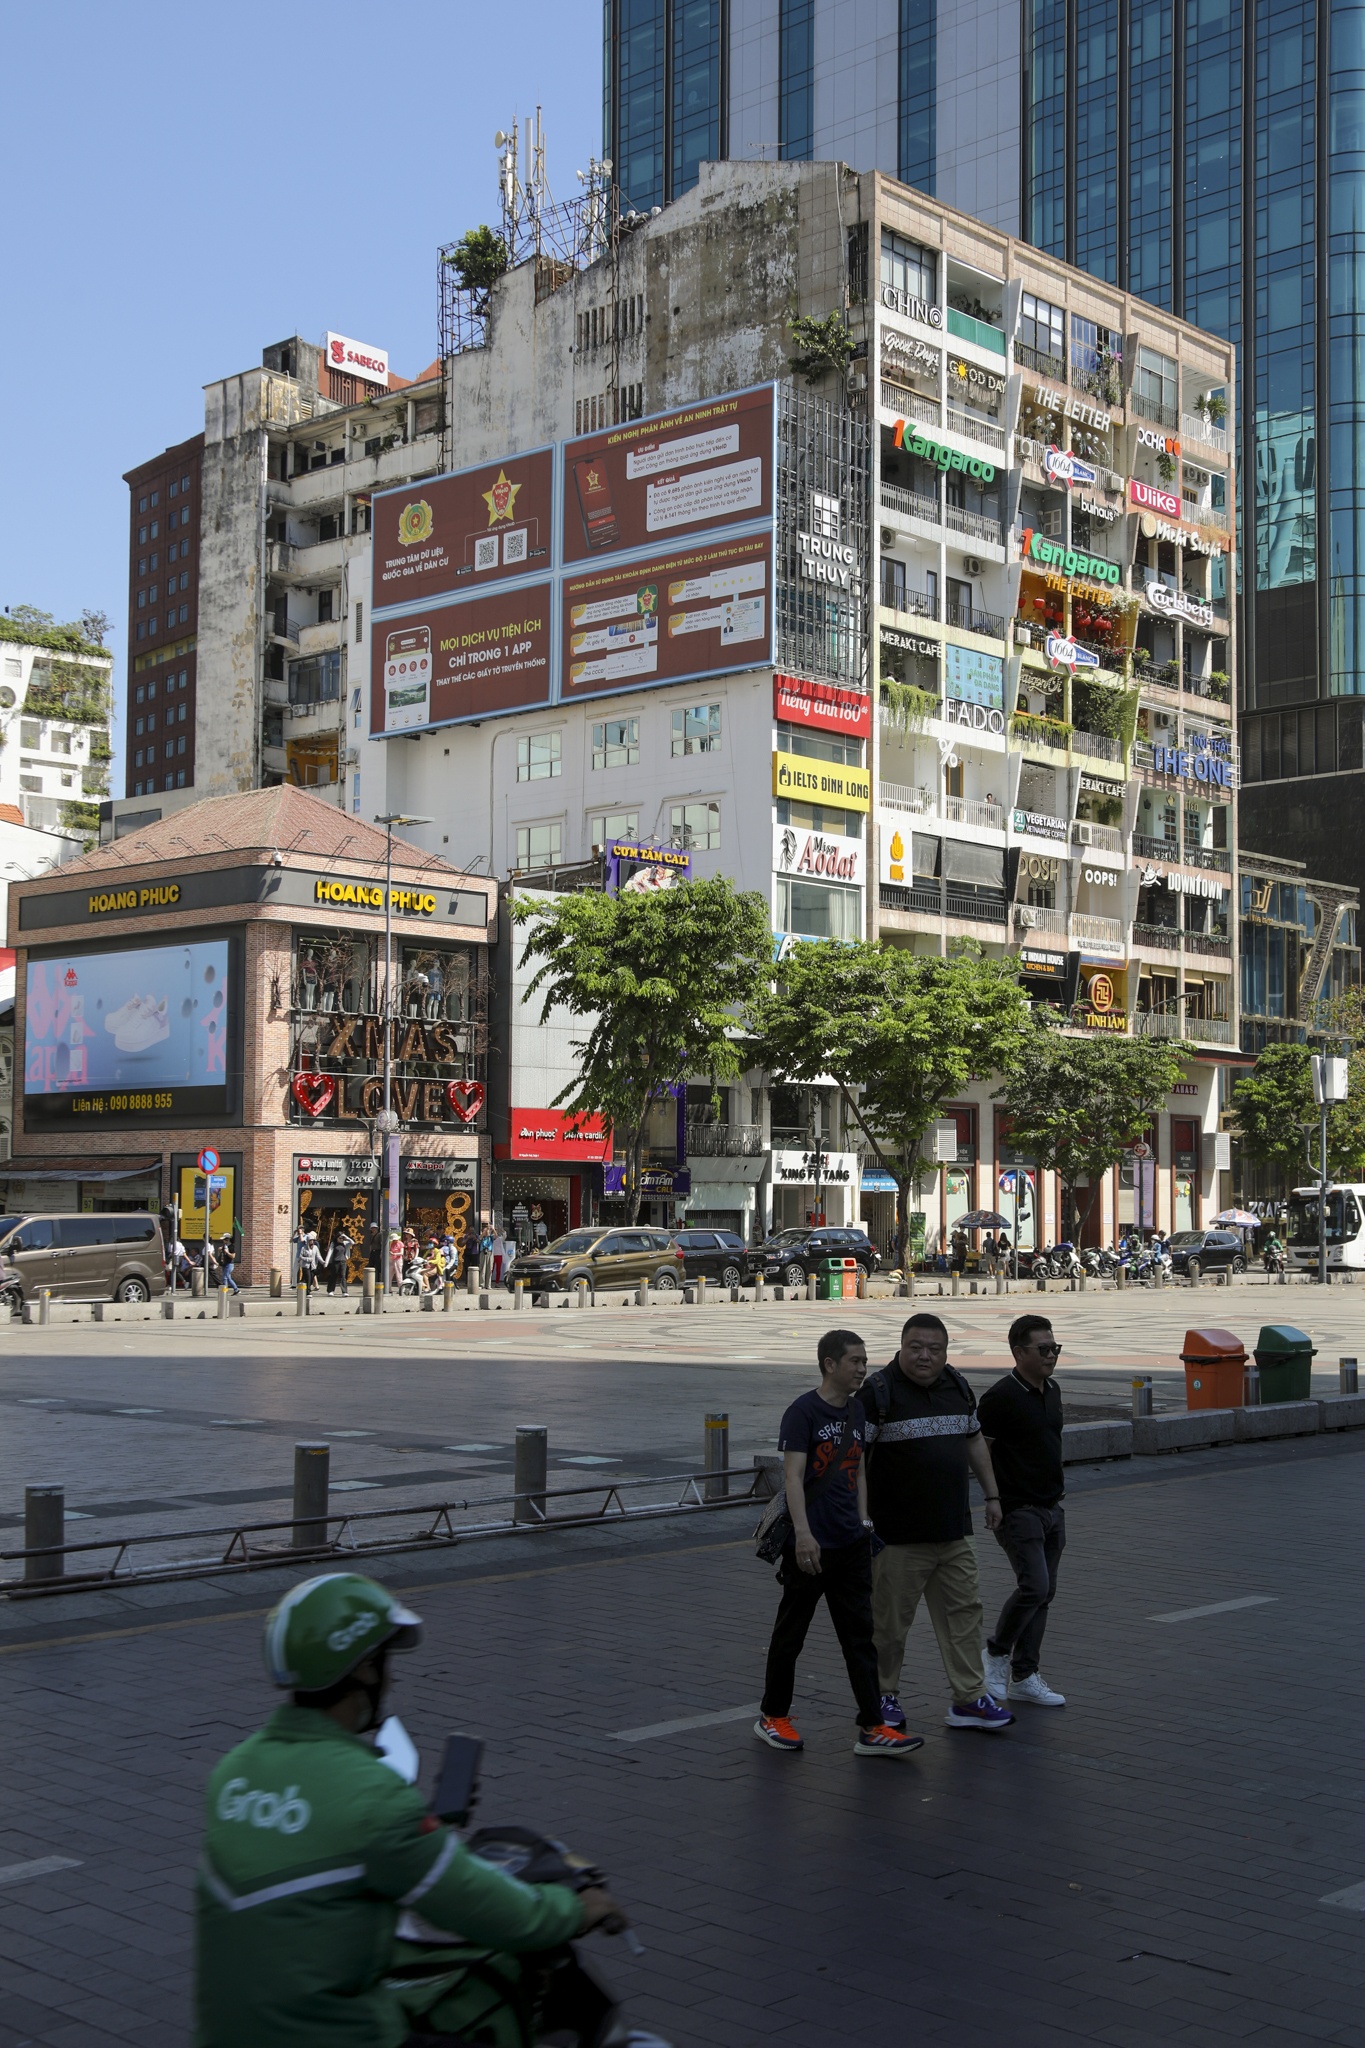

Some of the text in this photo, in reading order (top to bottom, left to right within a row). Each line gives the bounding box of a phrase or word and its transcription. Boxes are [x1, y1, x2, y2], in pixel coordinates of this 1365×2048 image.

[347, 351, 386, 374] SABECO
[989, 376, 1007, 394] DAY
[623, 429, 640, 440] NGHỊ
[684, 414, 694, 423] AN
[695, 410, 712, 420] NINH
[713, 404, 728, 416] TRẬT
[729, 401, 738, 412] TỰ
[1038, 385, 1111, 433] THE LETTER
[1052, 457, 1071, 475] 1664
[1136, 483, 1176, 512] Ulike
[385, 546, 444, 569] TRUNG TÂM DỮ LIỆU
[652, 564, 665, 573] DANH
[754, 542, 764, 550] BAY
[800, 534, 854, 564] TRUNG
[1190, 531, 1221, 558] Sushi
[382, 557, 449, 581] QUỐC GIA VỀ DÂN CƯ
[805, 559, 849, 585] THUY
[1046, 573, 1113, 607] THE LETTER
[1146, 581, 1214, 626] Carlsberg
[440, 619, 542, 651] MỌI DỊCH VỤ TIỆN ÍCH
[880, 630, 942, 659] MERAKI CAFÉ
[449, 641, 532, 668] CHỈ TRONG 1 APP
[1054, 643, 1074, 659] 1664
[436, 677, 450, 686] THAY
[462, 671, 475, 681] CÁC
[779, 688, 810, 717] Tiếng
[839, 701, 860, 722] 180
[946, 698, 1004, 735] FADO
[1154, 746, 1232, 787] THE ONE
[793, 771, 869, 799] IELTS ĐÌNH LONG
[1107, 784, 1126, 798] CAFÉ
[1016, 813, 1023, 823] 21
[1026, 814, 1067, 831] VEGETARIAN
[813, 836, 835, 855] Miss
[664, 853, 689, 866] CALI
[1086, 869, 1117, 887] OOPS!
[1168, 872, 1222, 900] DOWNTOWN
[89, 884, 180, 914] HOANG PHUC
[317, 881, 436, 913] HOANG PHUC
[1026, 963, 1042, 971] KITCHEN
[1027, 952, 1064, 966] INDIAN HOUSE
[327, 1016, 457, 1063] XMAS
[72, 1093, 172, 1115] Liên Hệ 090 8888 955
[337, 1078, 444, 1121] LOVE
[310, 1175, 338, 1183] SUPERGA
[416, 1162, 444, 1171] Kappa
[781, 1168, 806, 1179] XING
[823, 1169, 850, 1180] TANG
[84, 1200, 91, 1208] 97
[278, 1205, 288, 1214] 52
[217, 1777, 311, 1834] Grab
